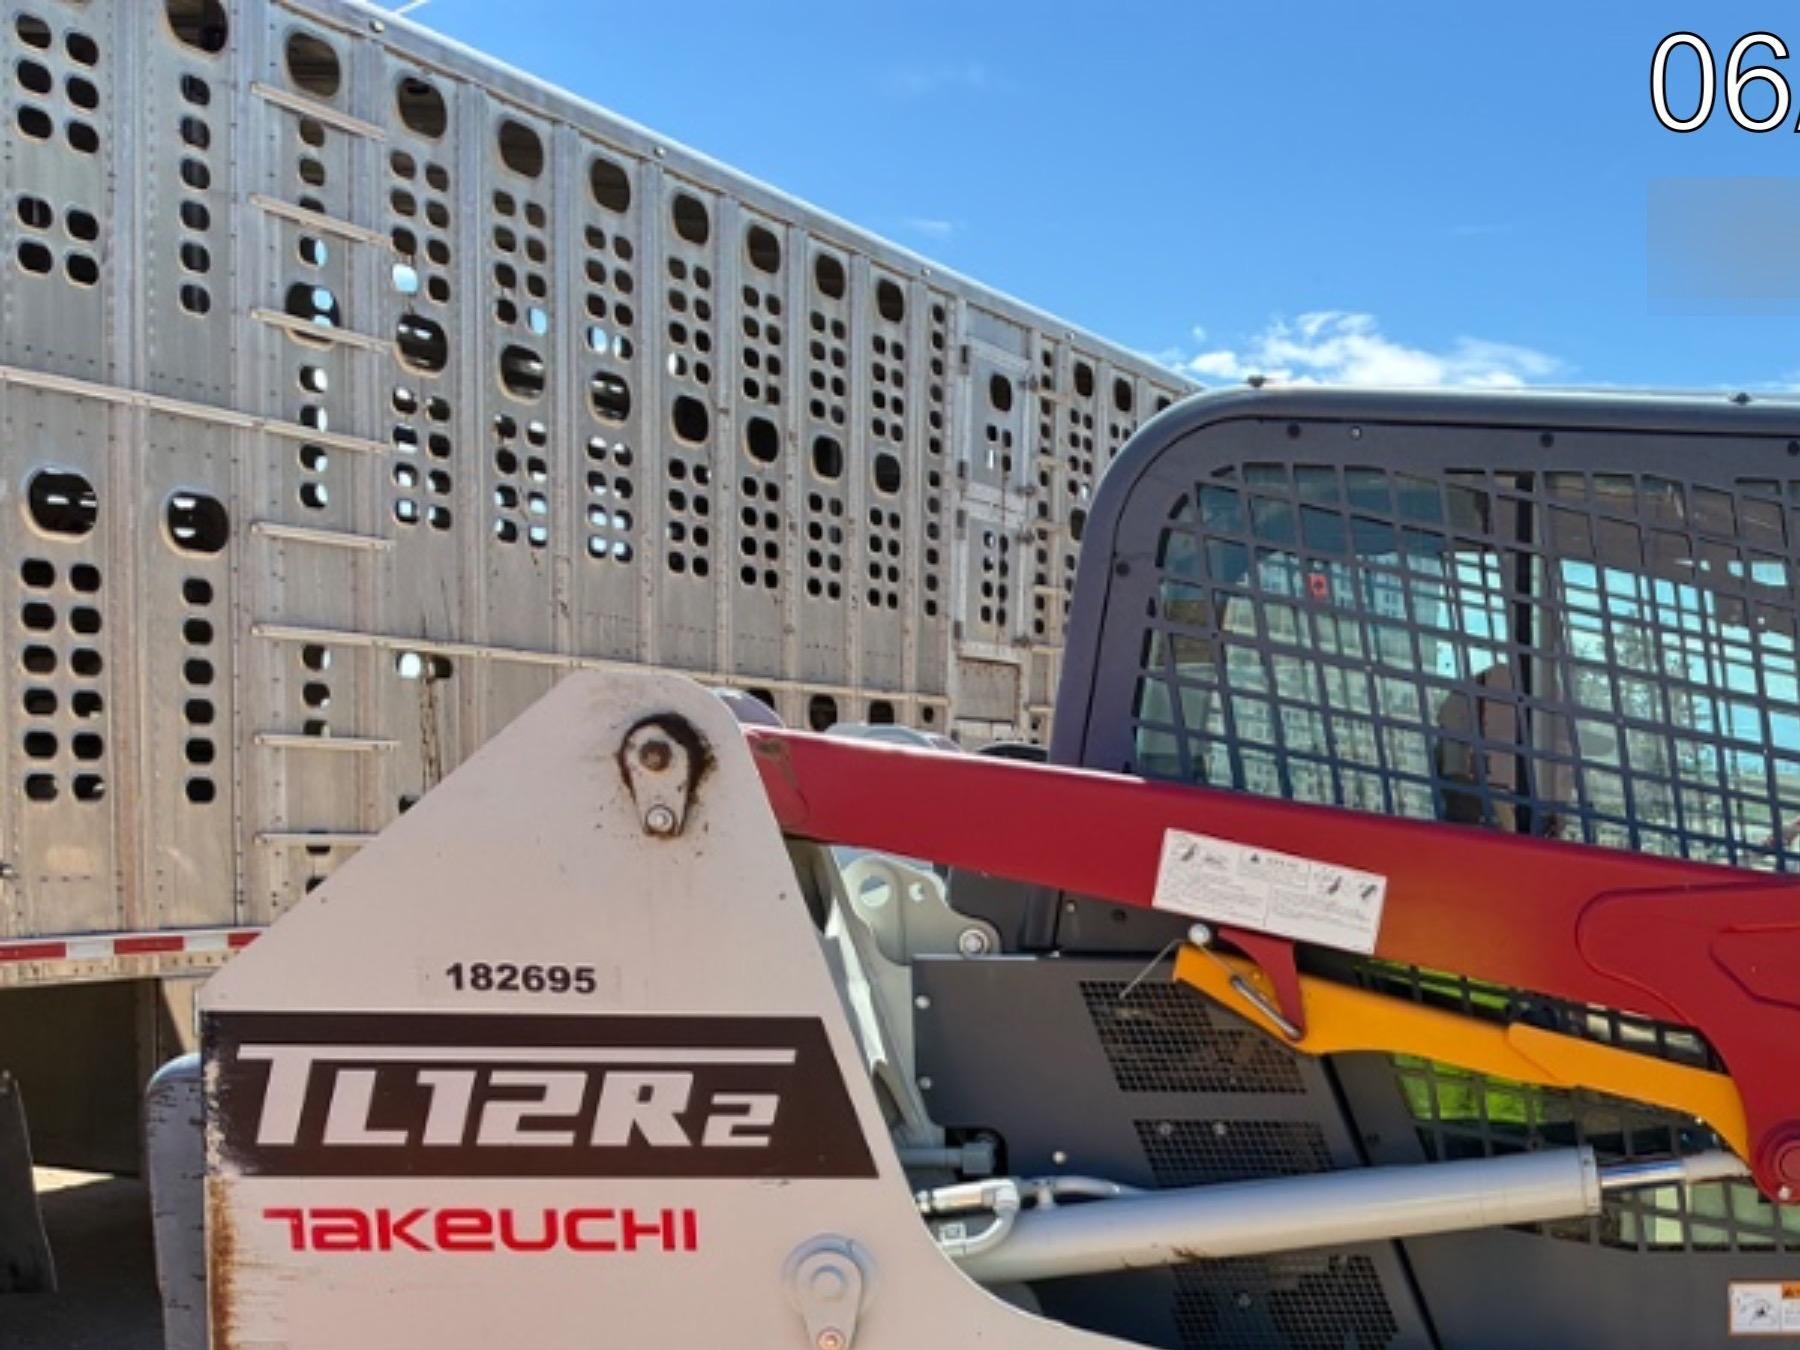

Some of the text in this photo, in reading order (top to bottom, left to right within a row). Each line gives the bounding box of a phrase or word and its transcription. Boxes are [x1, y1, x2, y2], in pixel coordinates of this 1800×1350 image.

[446, 962, 597, 994] 182695
[237, 1044, 797, 1148] TL12R2
[263, 1206, 699, 1255] TAKEUCHI
